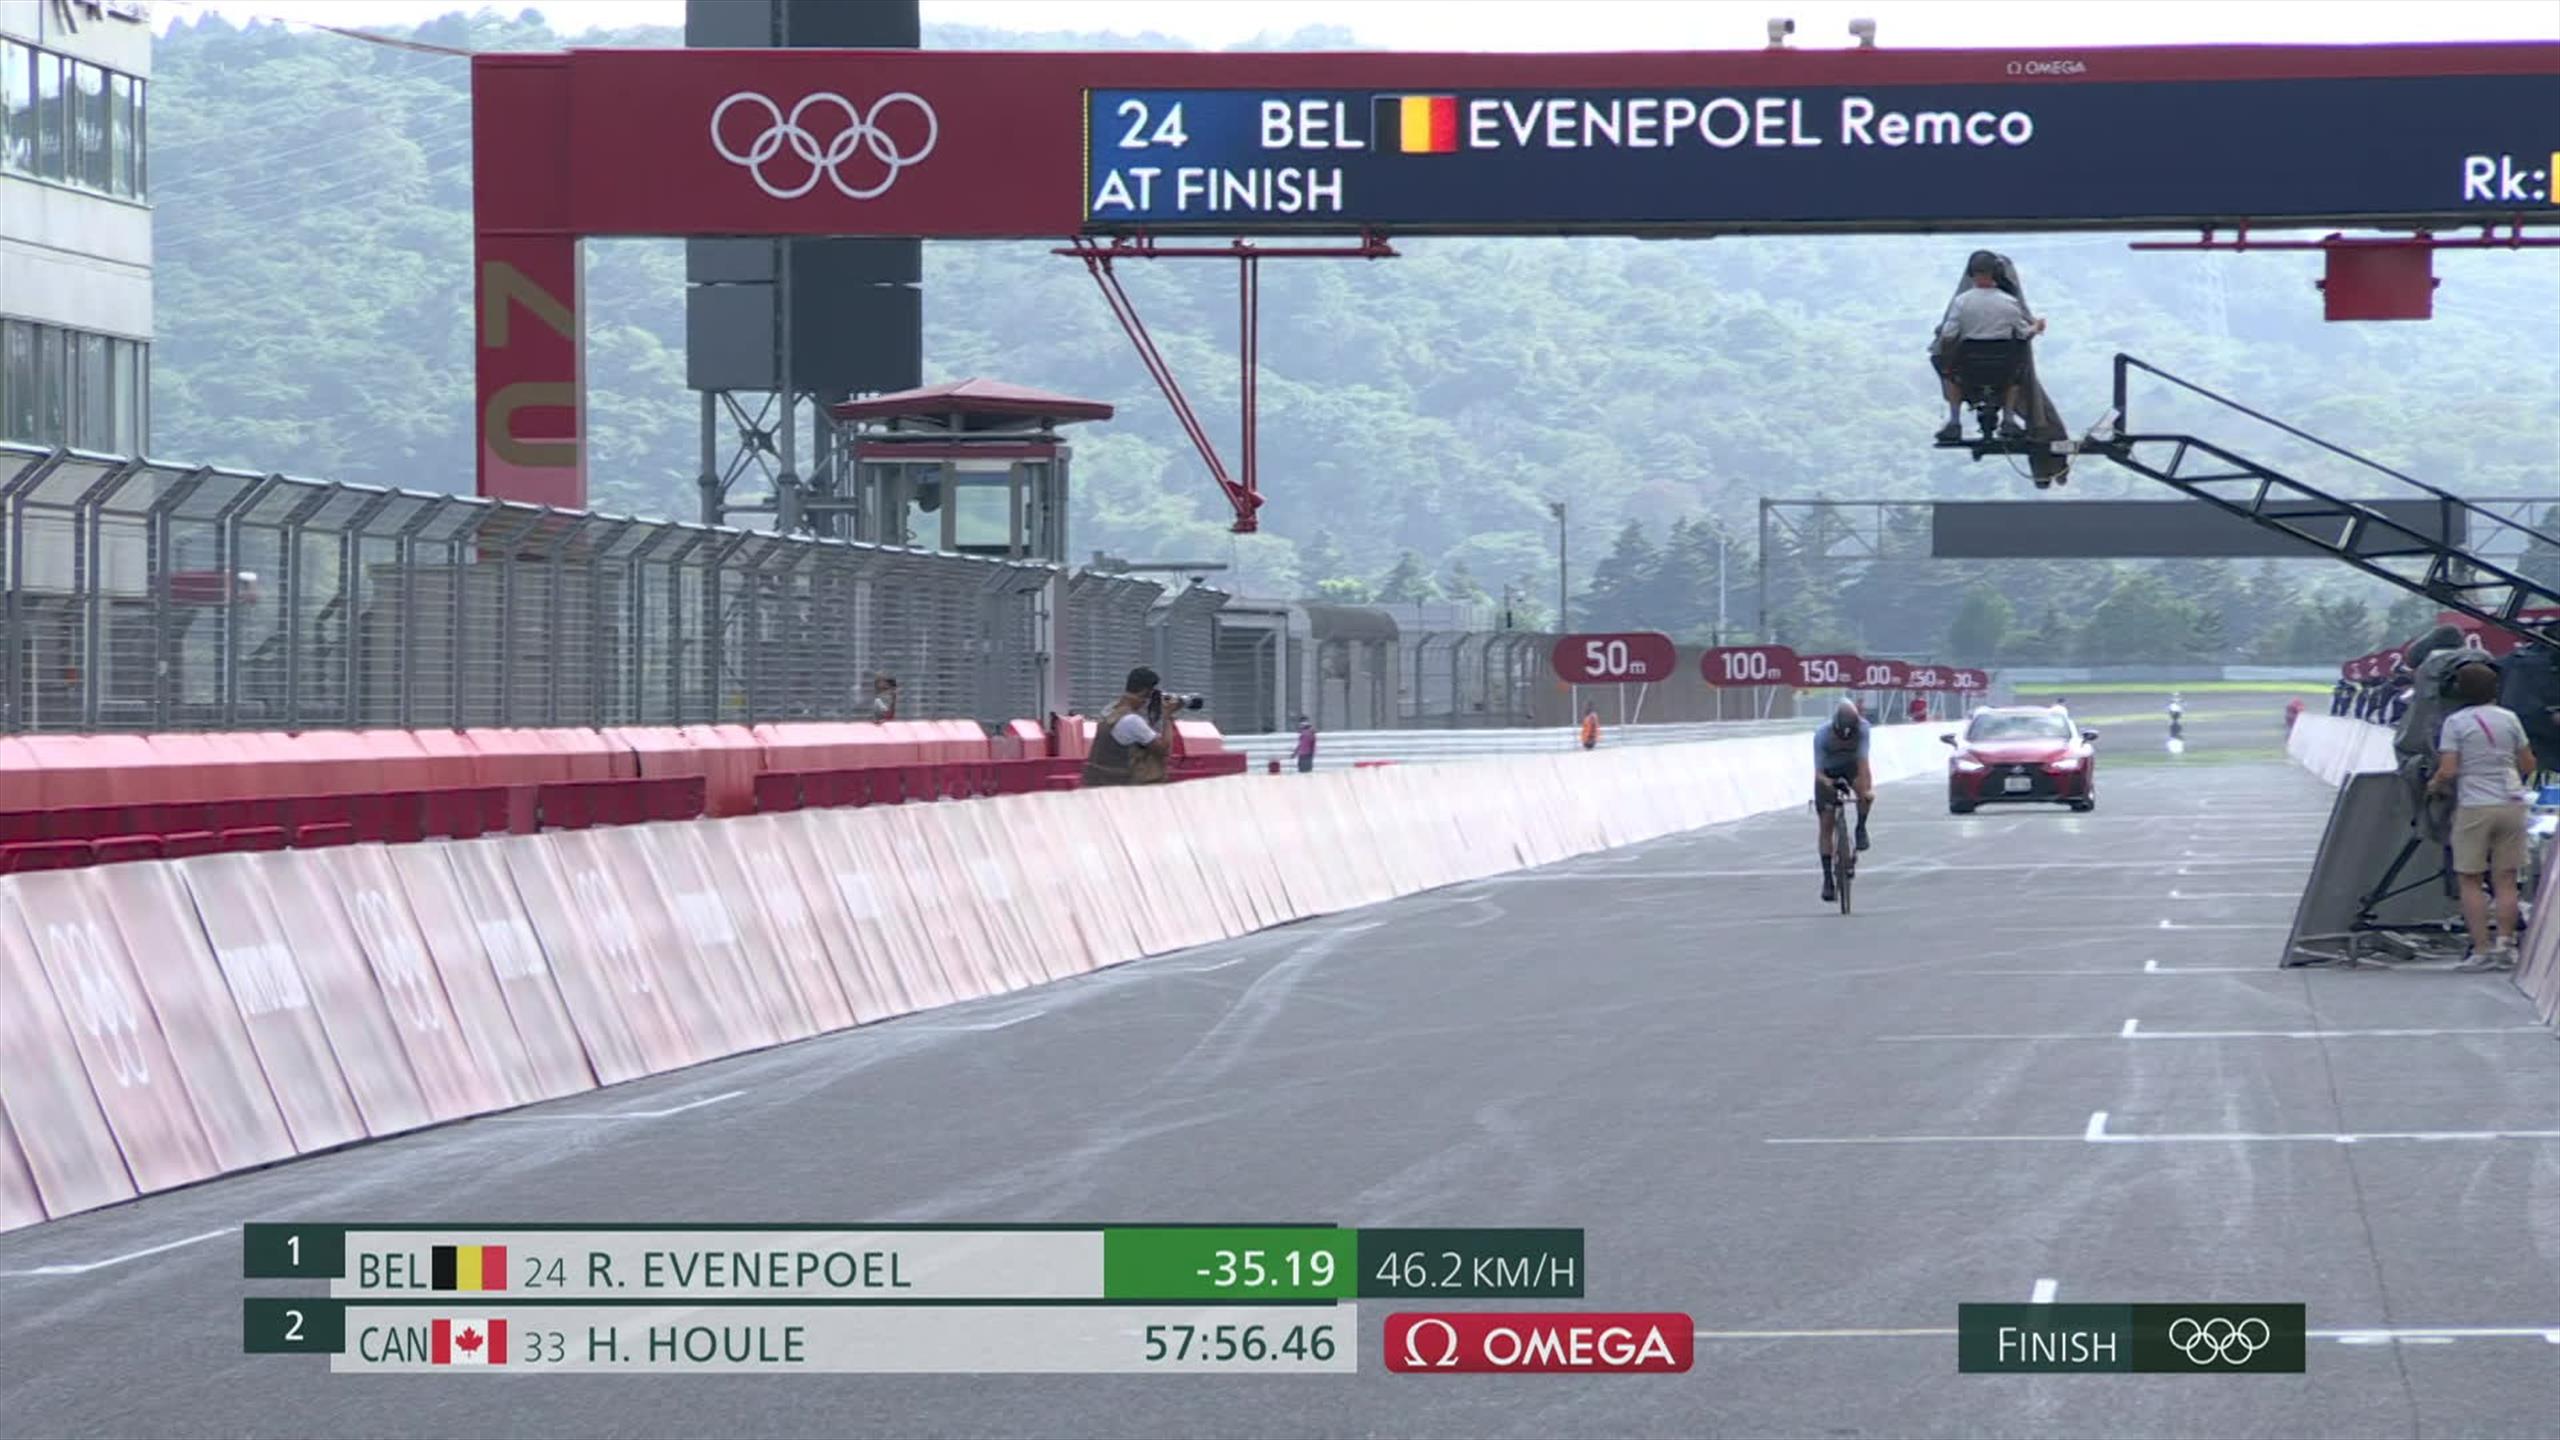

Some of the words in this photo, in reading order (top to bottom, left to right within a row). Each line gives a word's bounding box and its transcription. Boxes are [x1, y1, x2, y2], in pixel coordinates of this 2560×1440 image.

[2024, 60, 2087, 75] OMEGA
[1117, 99, 1189, 149] 24
[1260, 99, 1366, 149] BEL
[1469, 97, 1823, 148] EVENEPOEL
[1841, 97, 2034, 147] Remco
[1092, 166, 1162, 212] AT
[1176, 166, 1343, 213] FINISH
[2463, 154, 2546, 201] Rk:
